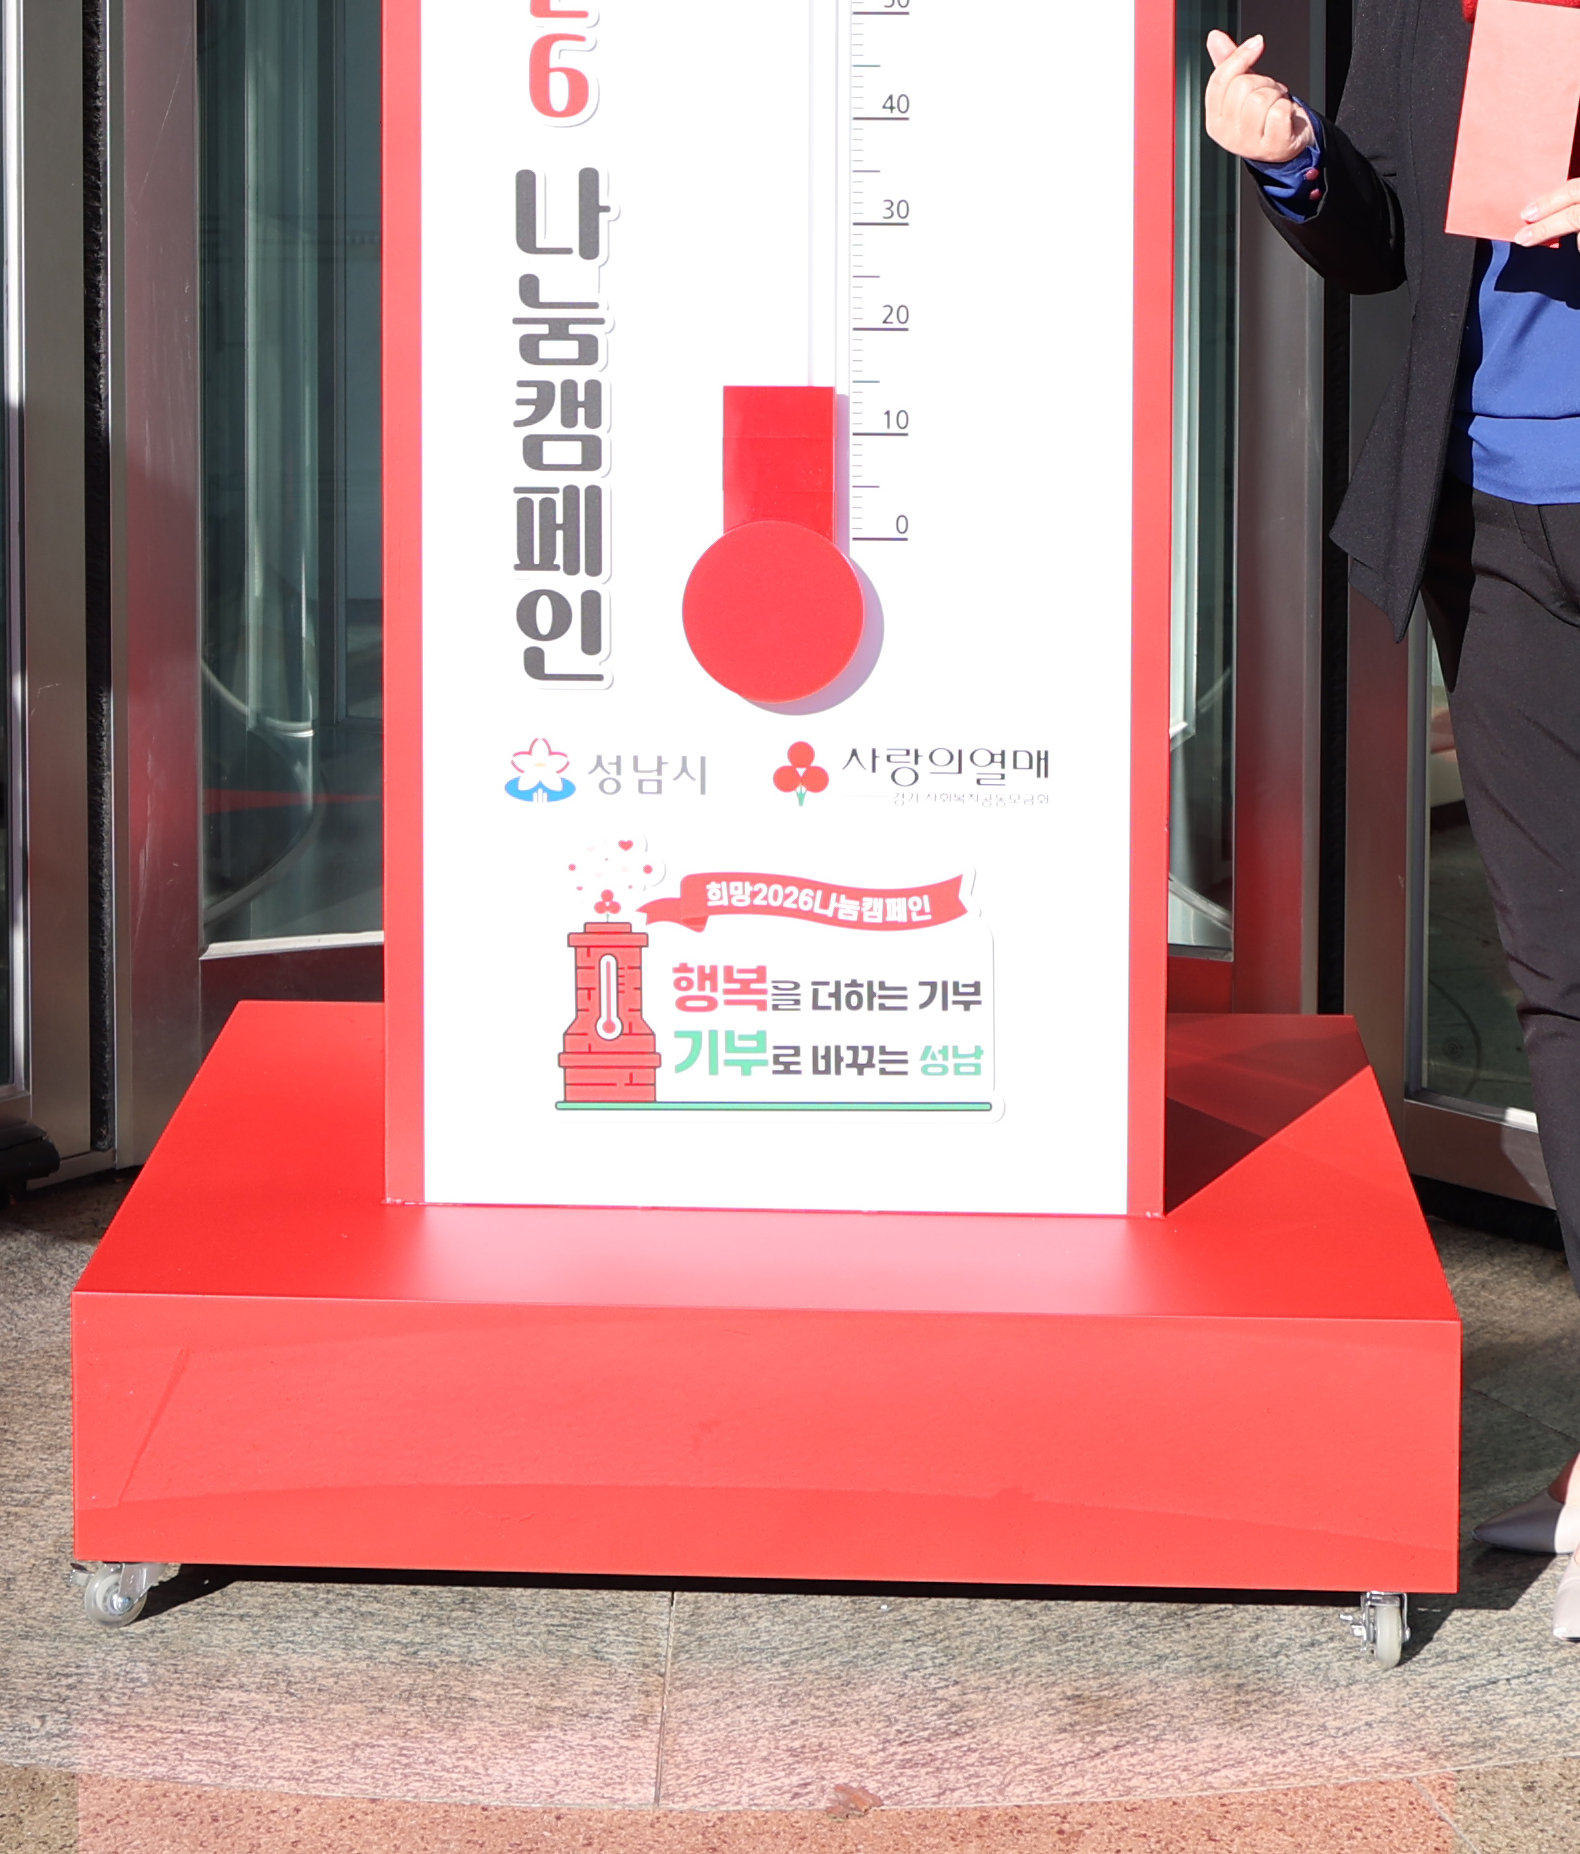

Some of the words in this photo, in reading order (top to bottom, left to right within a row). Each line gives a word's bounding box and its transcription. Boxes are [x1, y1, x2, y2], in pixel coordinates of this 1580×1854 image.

[881, 94, 911, 115] 40
[881, 199, 911, 220] 30
[881, 304, 910, 325] 20
[511, 166, 612, 682] 나눔캠페인
[882, 409, 910, 430] 10
[895, 514, 910, 535] 0
[587, 754, 707, 796] 성남시
[842, 747, 1050, 787] 사랑의열매
[892, 791, 920, 807] 경기
[924, 791, 1050, 808] 사회복지공동모금회
[705, 880, 933, 924] 희망2026나눔캠페인
[671, 961, 802, 1013] 행복을
[810, 978, 909, 1012] 더하는
[917, 979, 983, 1012] 기부
[673, 1028, 803, 1077] 기부로
[810, 1044, 910, 1077] 바꾸는
[919, 1044, 985, 1077] 성남
